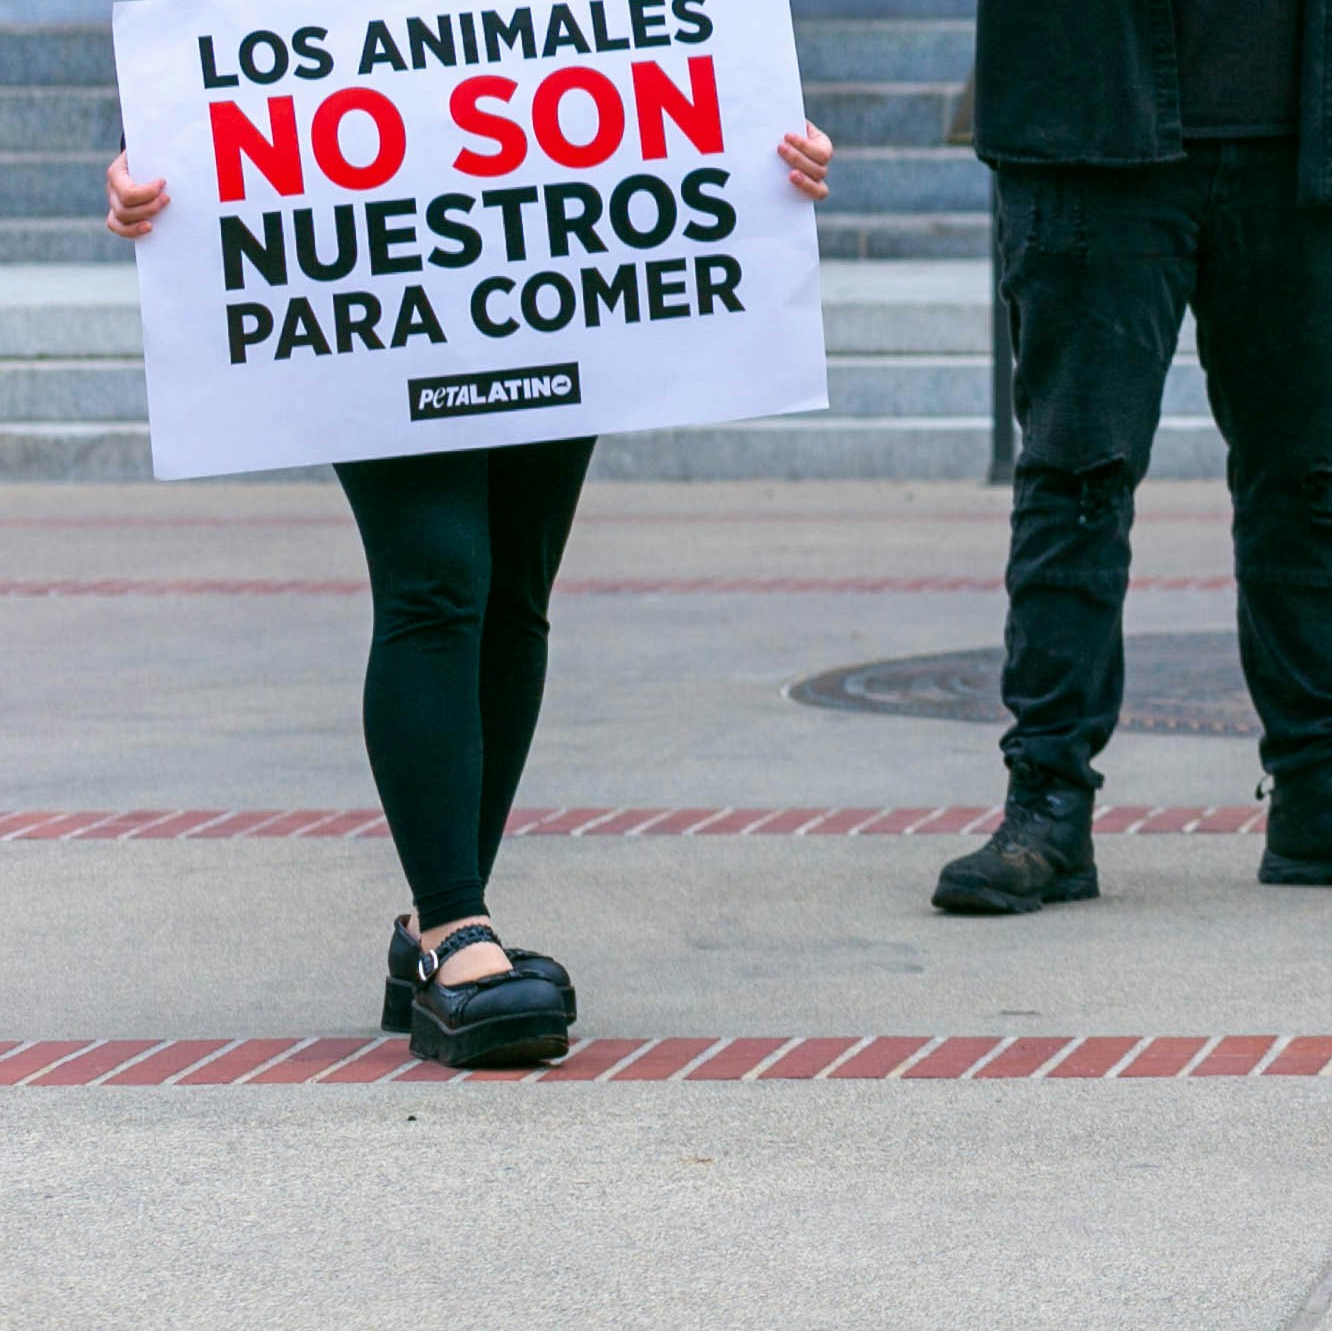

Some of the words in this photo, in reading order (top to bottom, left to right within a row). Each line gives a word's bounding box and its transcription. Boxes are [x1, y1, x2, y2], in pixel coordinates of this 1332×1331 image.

[199, 26, 334, 89] LOS
[209, 87, 406, 202] NO
[449, 55, 724, 177] SON
[220, 167, 737, 290] NUESTROS
[226, 284, 447, 365] PARA
[470, 254, 746, 338] COMER
